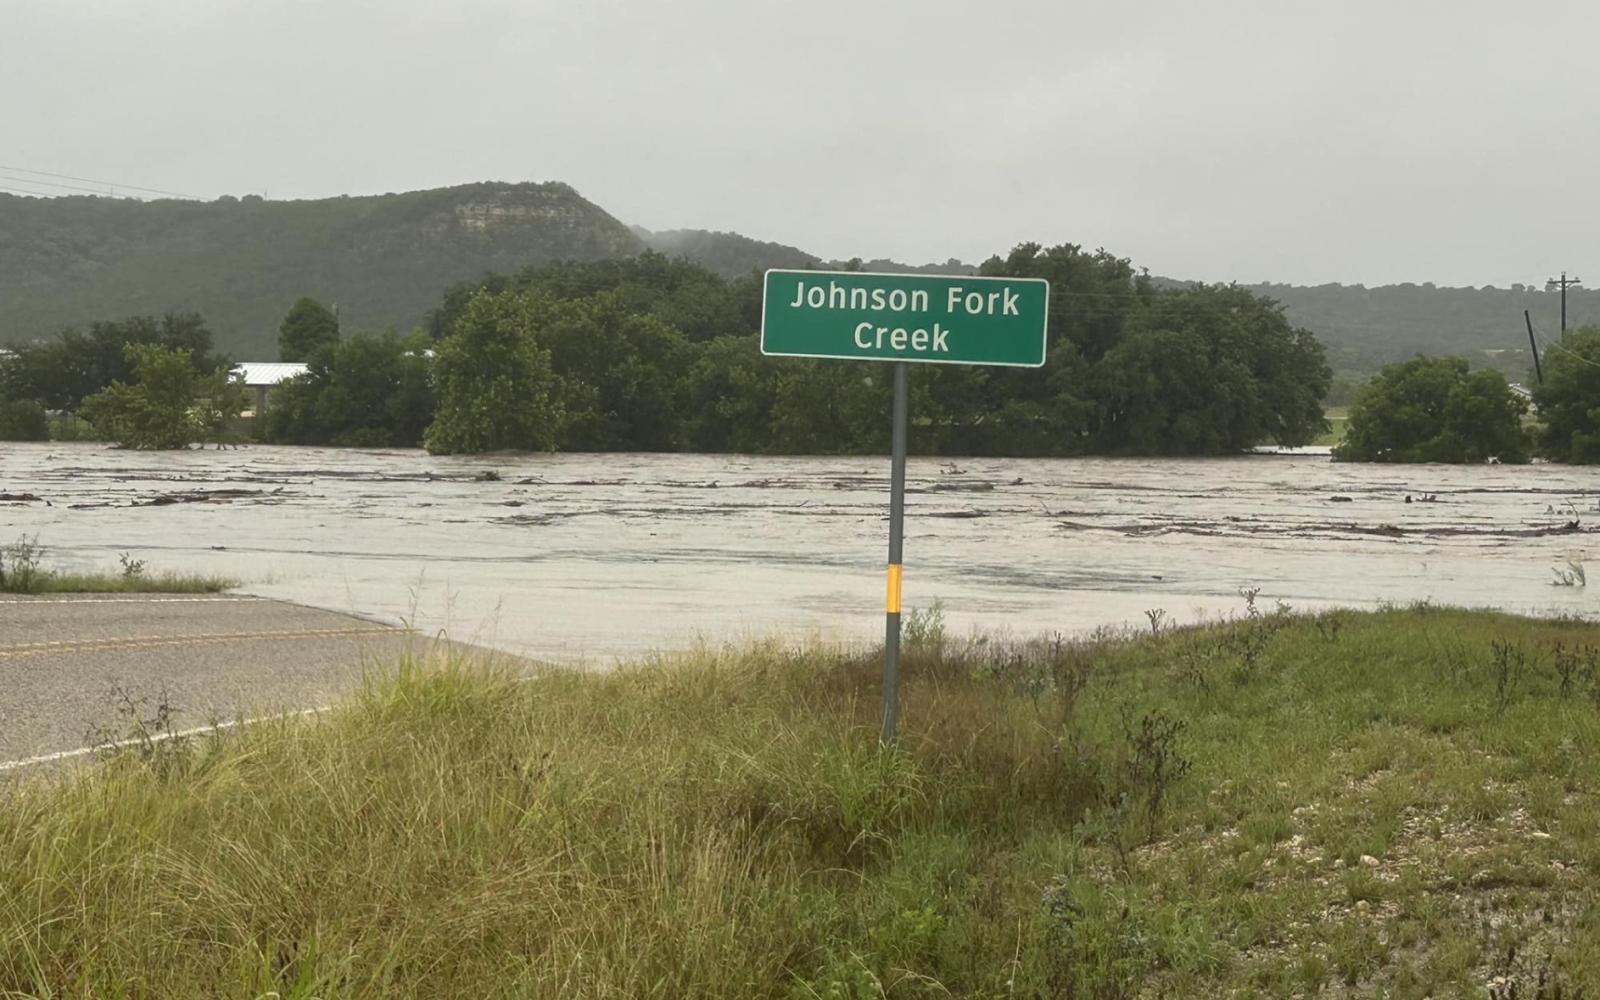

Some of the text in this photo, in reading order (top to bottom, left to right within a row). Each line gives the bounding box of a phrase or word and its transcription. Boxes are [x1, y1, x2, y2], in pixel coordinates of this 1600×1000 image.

[790, 281, 1020, 315] Johnson Fork
[854, 322, 950, 352] Creek
